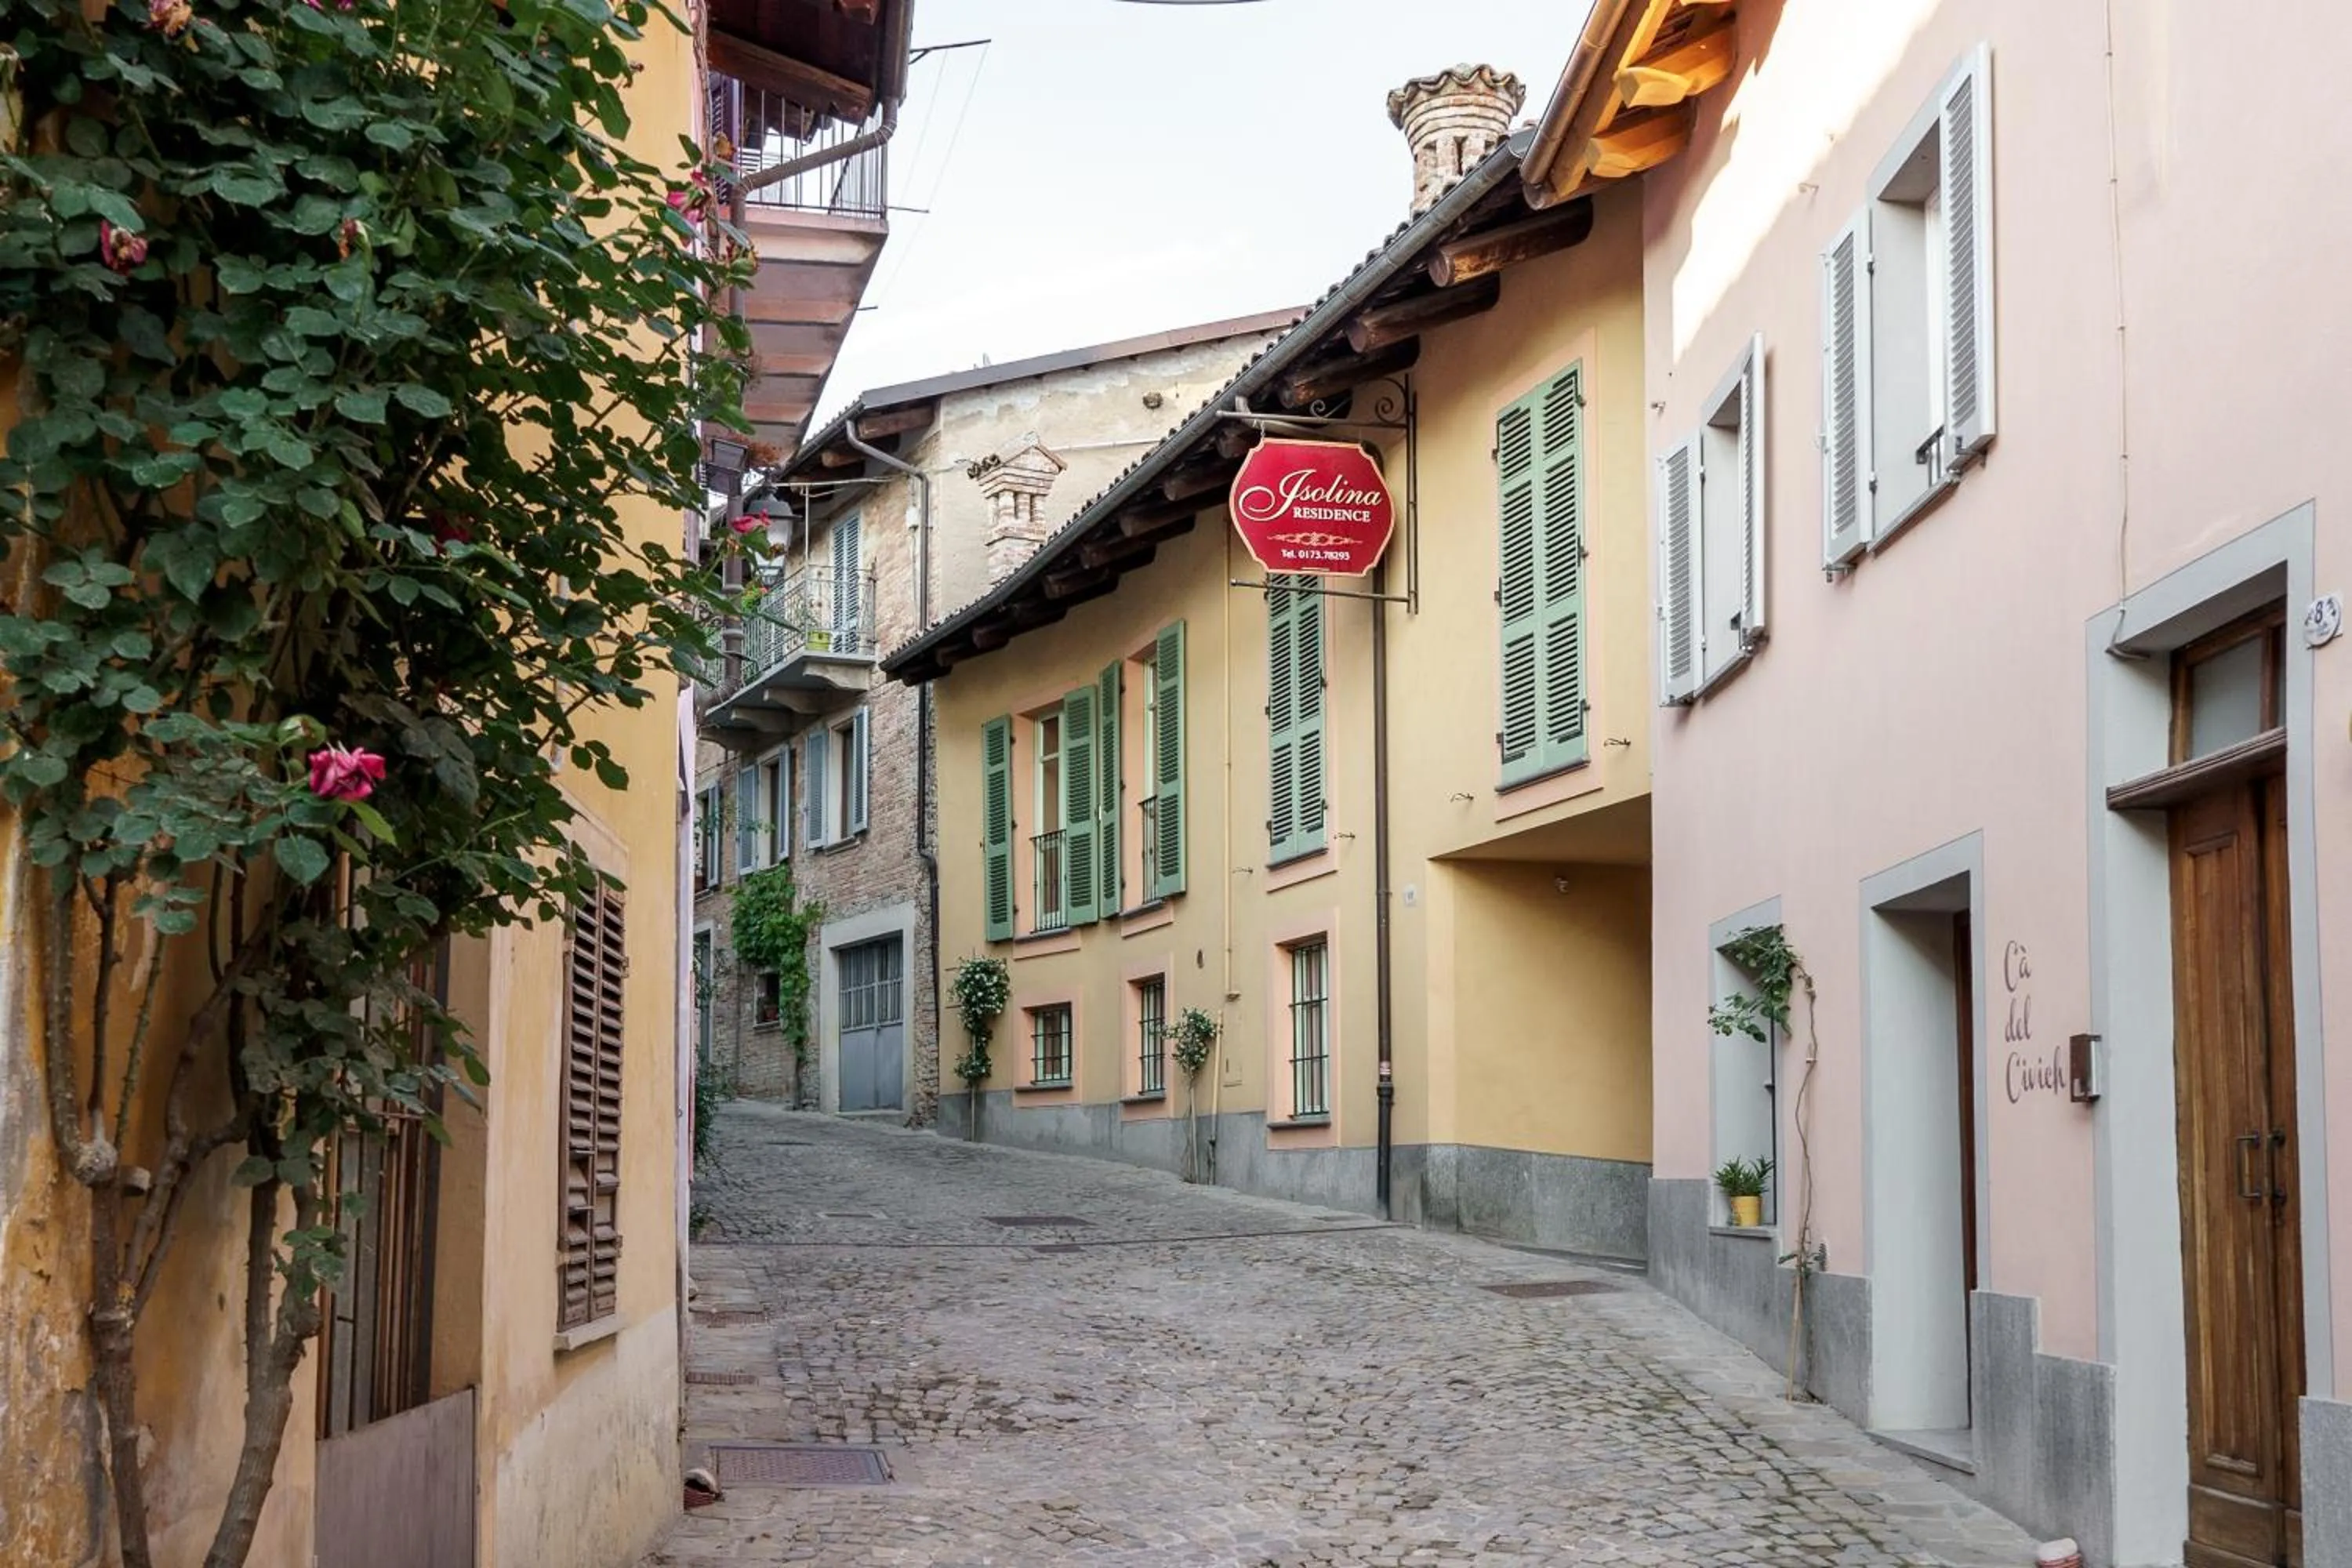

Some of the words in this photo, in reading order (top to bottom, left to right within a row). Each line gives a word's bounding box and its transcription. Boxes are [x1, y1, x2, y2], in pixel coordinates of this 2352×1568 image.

[1239, 469, 1382, 521] Isolina
[1293, 507, 1371, 522] RESIDENCE
[1281, 550, 1297, 559] Tel.
[2314, 600, 2324, 624] 8
[2004, 940, 2032, 993] Cà
[2005, 995, 2032, 1043] del
